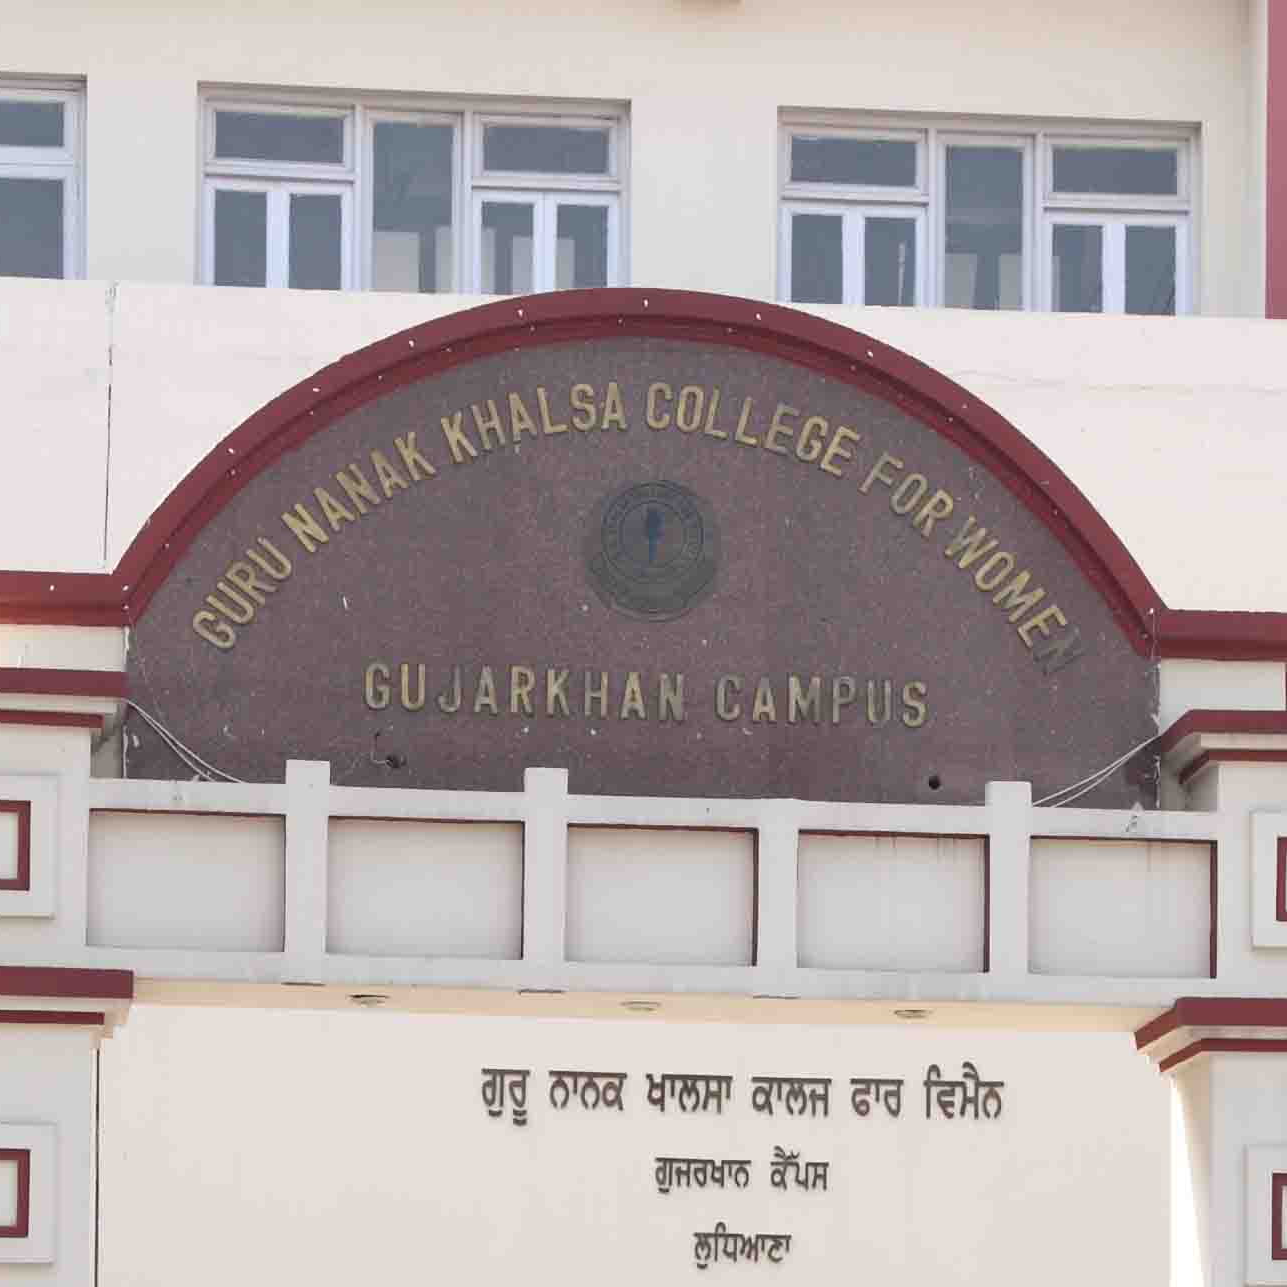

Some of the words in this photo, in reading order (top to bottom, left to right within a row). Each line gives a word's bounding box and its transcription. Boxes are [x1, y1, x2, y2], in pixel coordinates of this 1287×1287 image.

[192, 537, 291, 649] GURU
[281, 431, 436, 553] NANAK
[441, 384, 627, 464] KHALSA
[646, 382, 861, 477] COLLEGE
[858, 453, 954, 537] FOR
[944, 516, 1083, 677] WOMEN
[364, 663, 685, 721] GUJARKHAN
[715, 675, 929, 728] CAMPUS
[481, 1068, 531, 1126] ਗੁਰੂ
[548, 1070, 628, 1112] ਨਾਨਕ
[645, 1073, 733, 1114] ਖਾਲਸਾ
[751, 1076, 833, 1118] ਕਾਲਜ
[850, 1078, 905, 1118] ਫਾਰ
[655, 1157, 752, 1194] ਗੁਜਰਖਾਨ
